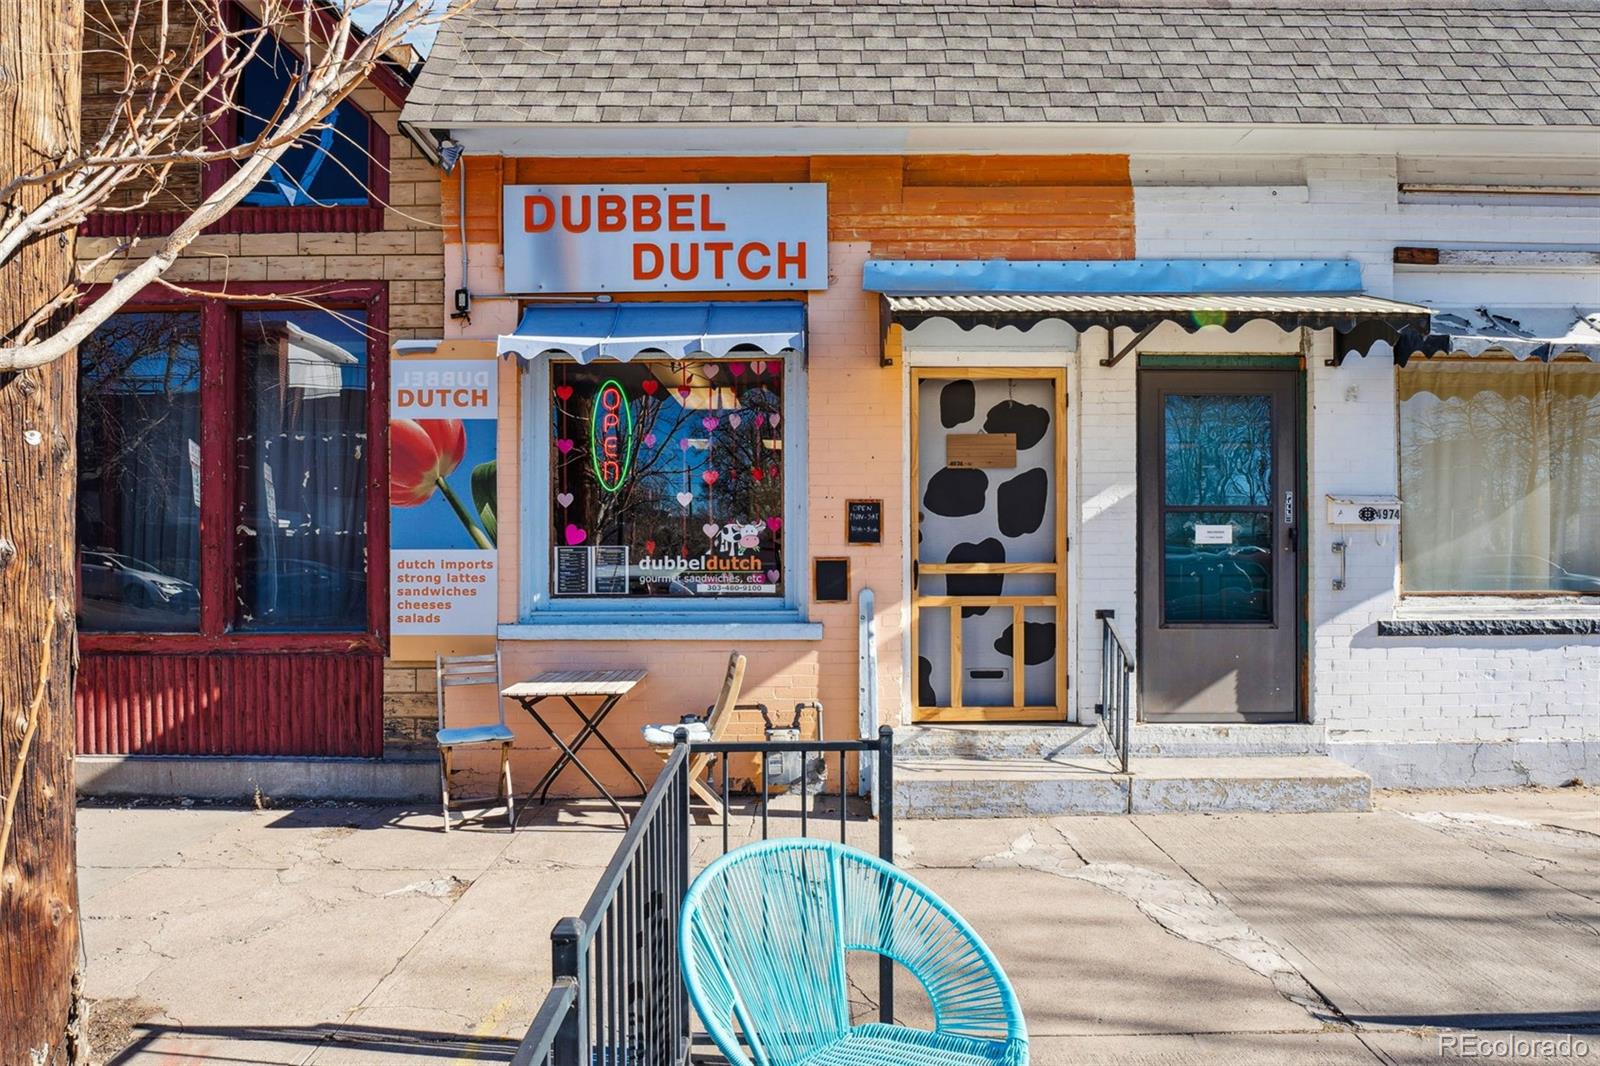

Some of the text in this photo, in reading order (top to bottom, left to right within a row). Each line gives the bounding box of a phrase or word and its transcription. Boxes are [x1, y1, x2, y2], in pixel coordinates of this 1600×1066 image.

[523, 194, 726, 233] DUBBEL
[632, 241, 807, 281] DUTCH
[397, 389, 488, 407] DUTCH
[397, 560, 493, 571] dutch imports
[639, 555, 762, 570] dubbeldutch
[397, 573, 486, 584] strong lattes
[397, 586, 477, 596] sandwiches
[397, 600, 452, 609] cheeses
[397, 613, 441, 623] salads
